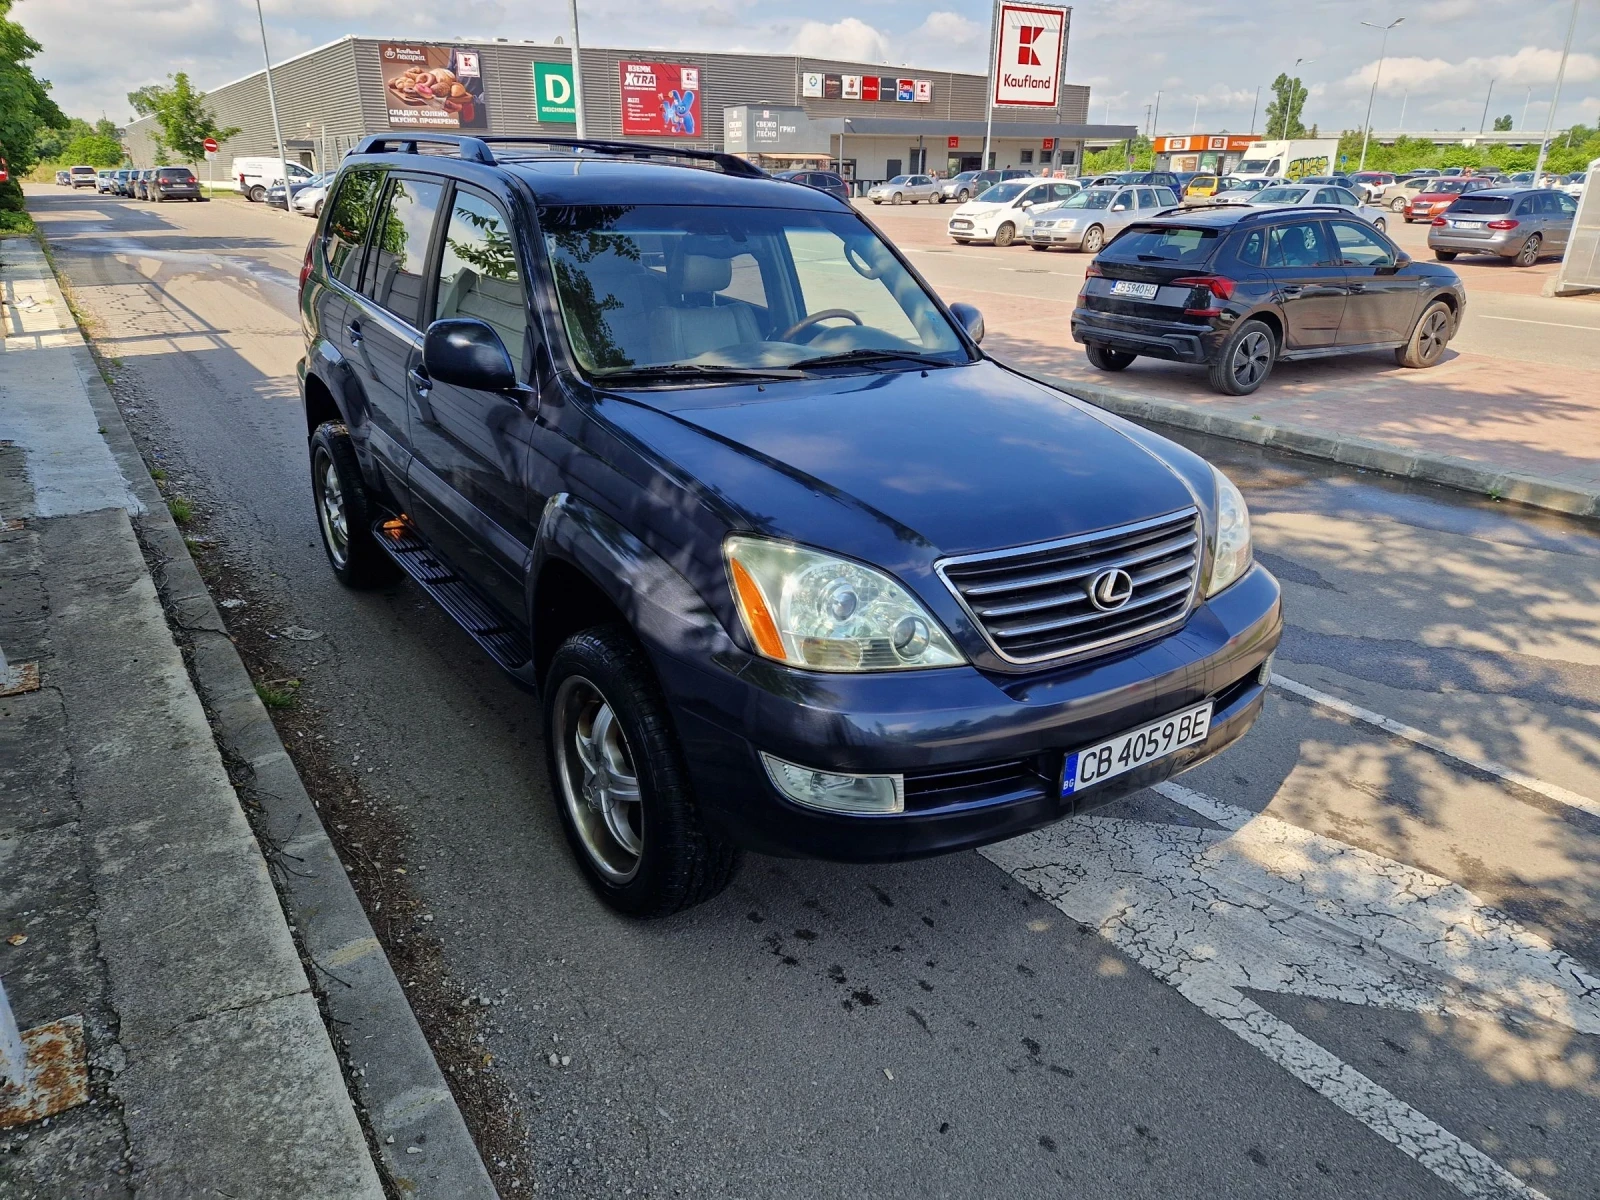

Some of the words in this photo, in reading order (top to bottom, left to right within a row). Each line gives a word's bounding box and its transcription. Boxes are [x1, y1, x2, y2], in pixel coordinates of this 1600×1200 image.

[1018, 26, 1045, 66] K
[624, 72, 656, 86] XTRA
[1003, 73, 1051, 89] Kaufland
[544, 73, 571, 104] D
[899, 83, 913, 91] Easy
[1115, 281, 1126, 292] CB
[1126, 283, 1144, 294] 5940
[1080, 745, 1112, 783] CB
[1118, 722, 1175, 767] 4059
[1176, 708, 1208, 745] BE
[1063, 778, 1075, 790] BG
